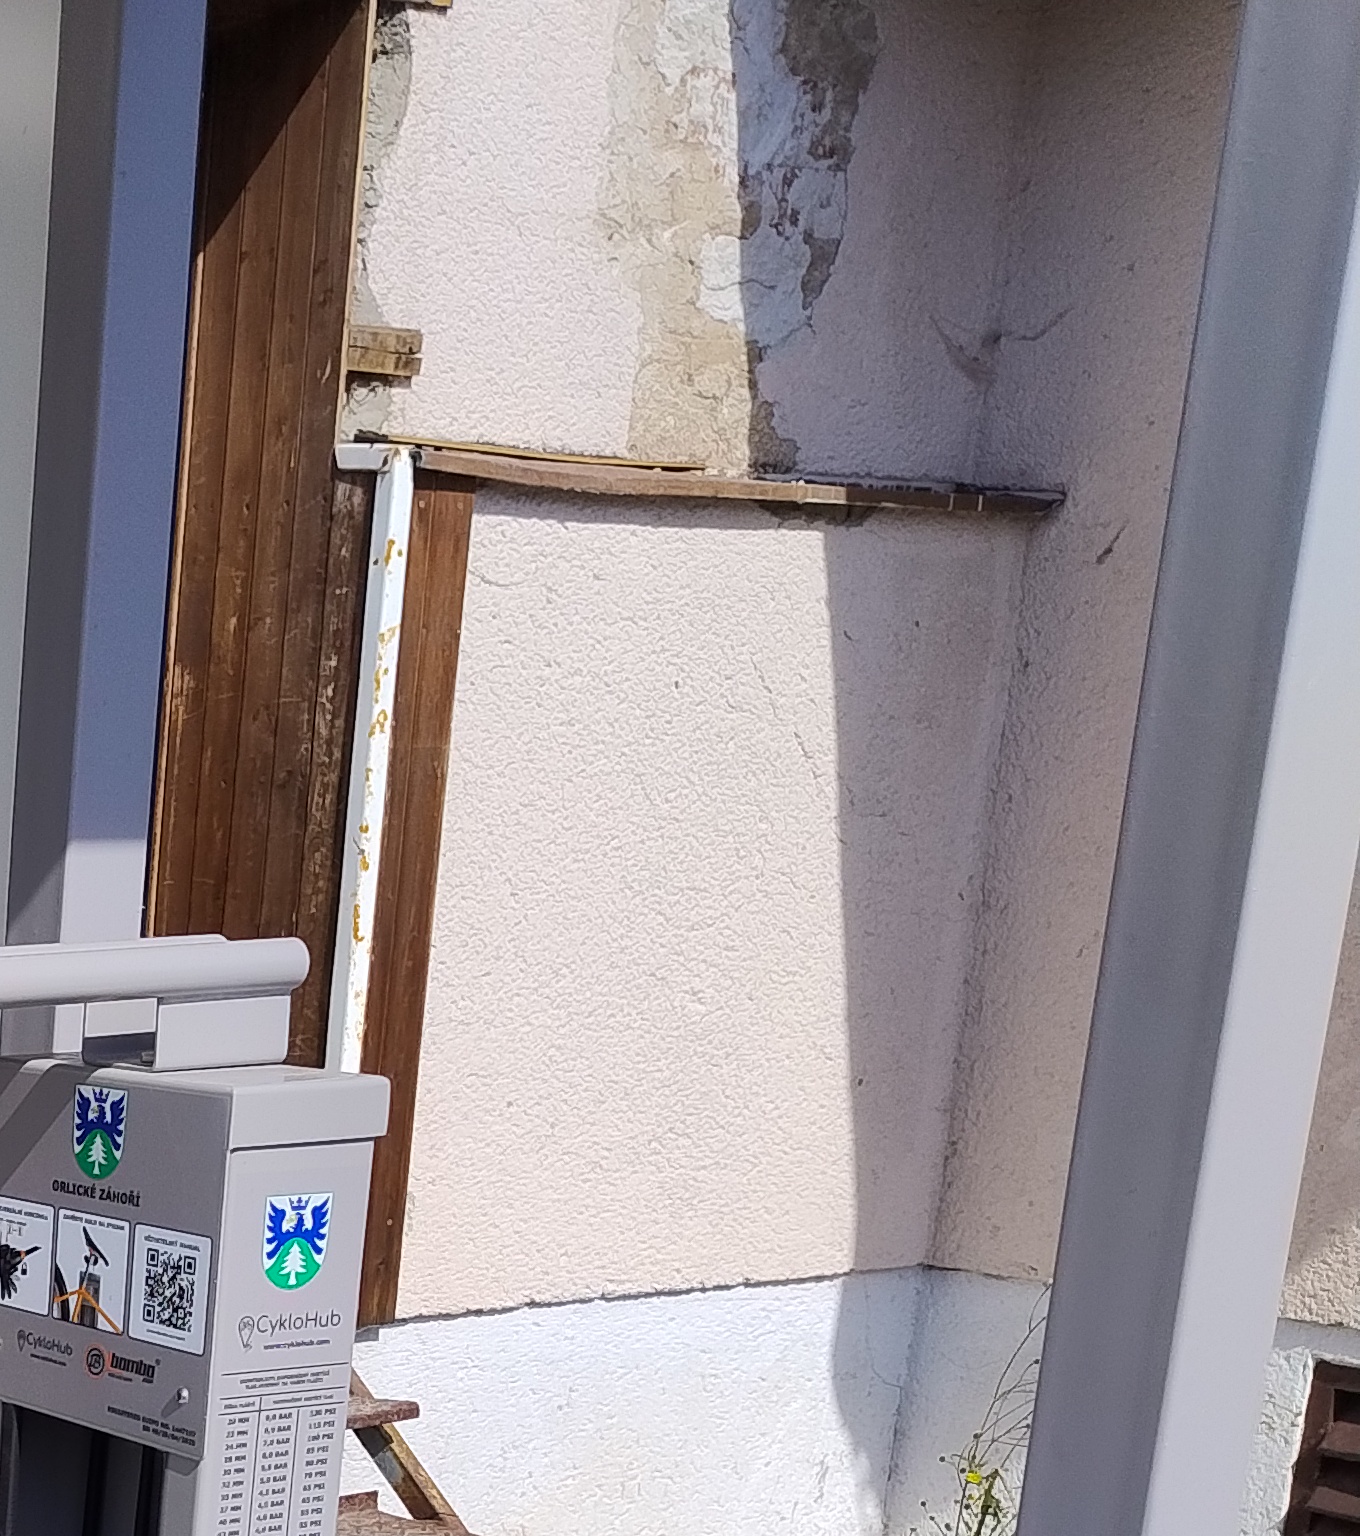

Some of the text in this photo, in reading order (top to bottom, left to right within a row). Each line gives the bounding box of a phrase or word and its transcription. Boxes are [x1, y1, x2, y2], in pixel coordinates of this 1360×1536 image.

[51, 1179, 141, 1207] ORLICKÉ ZÁHOŘÍ
[257, 1309, 341, 1338] CykloHub
[27, 1332, 73, 1356] CykloHub
